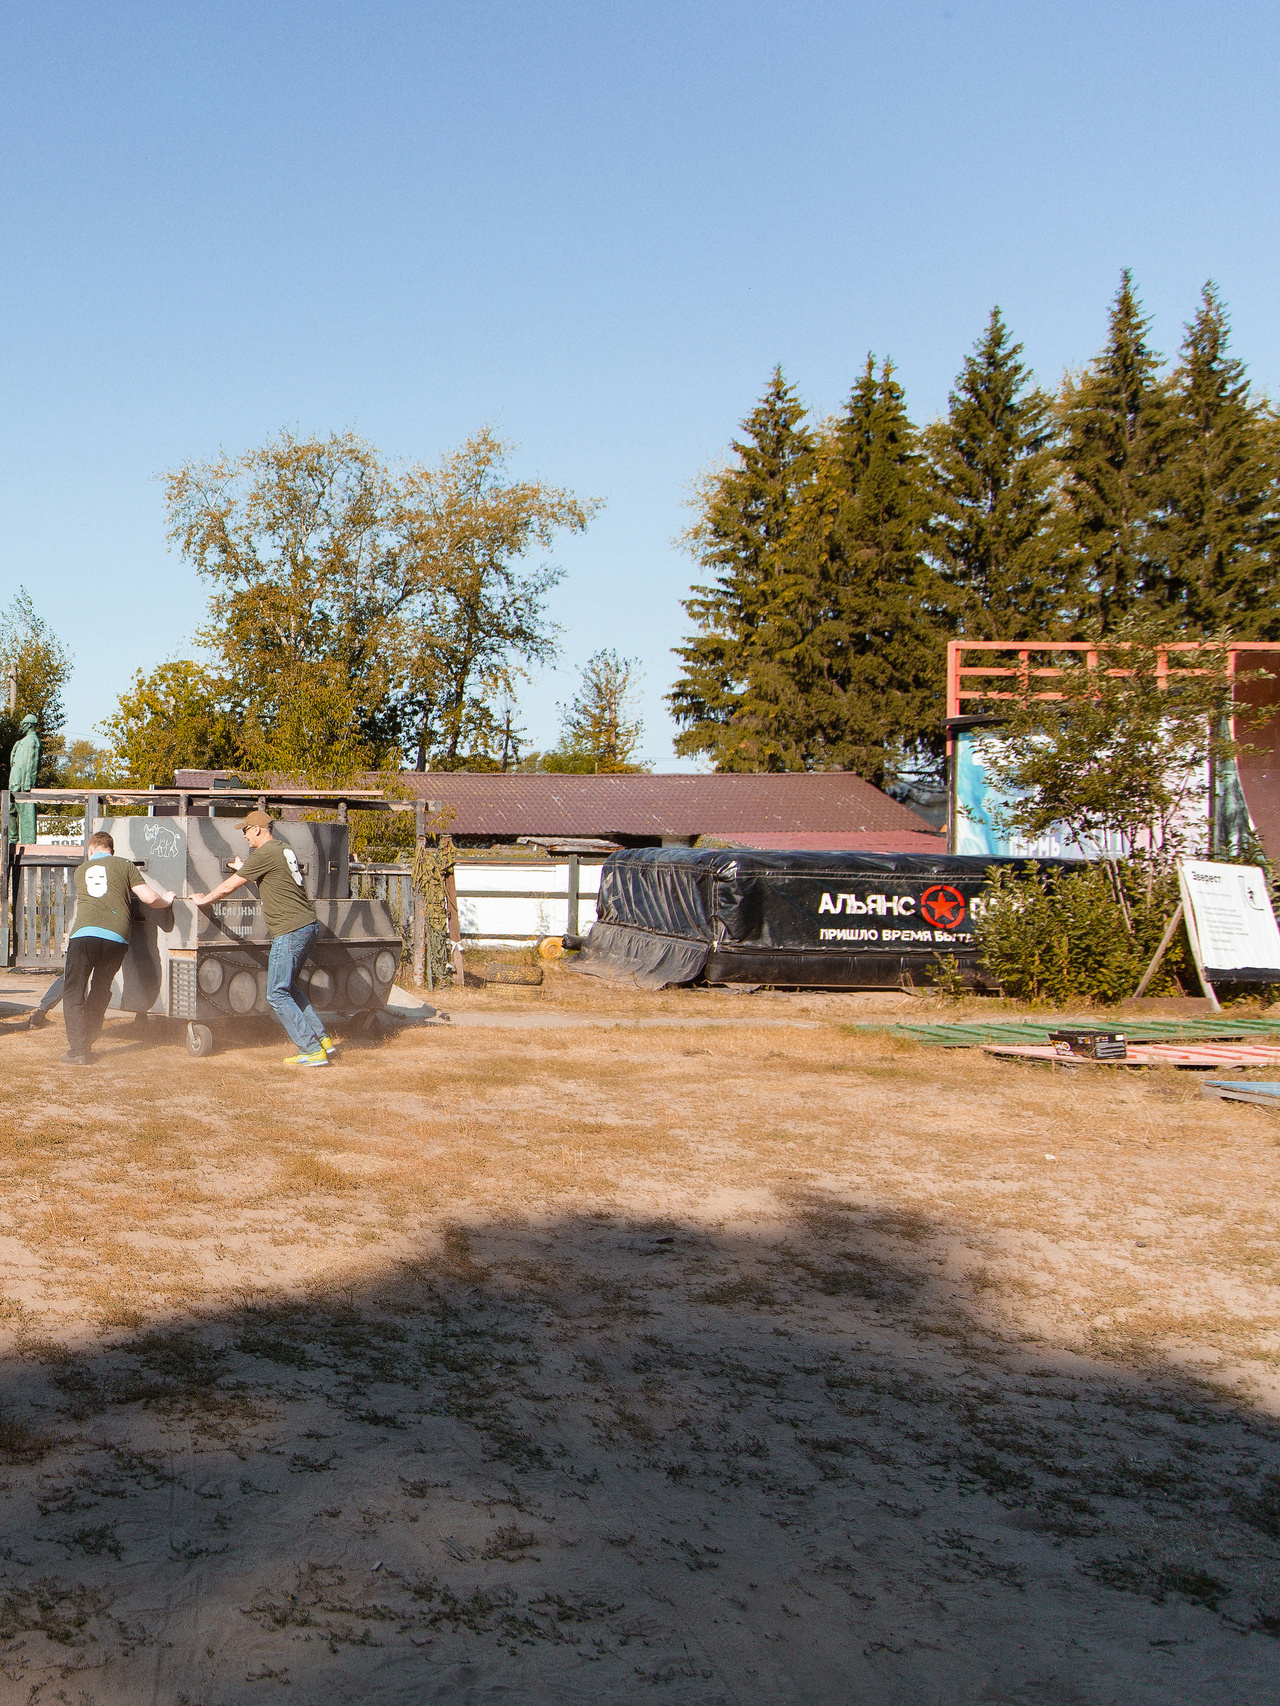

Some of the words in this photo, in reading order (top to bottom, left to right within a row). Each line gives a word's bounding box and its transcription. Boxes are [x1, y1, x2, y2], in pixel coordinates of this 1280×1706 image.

[818, 892, 917, 916] АЛЬЯНС
[819, 928, 879, 941] ПРИШЛО
[881, 929, 934, 942] ВРЕМЯ
